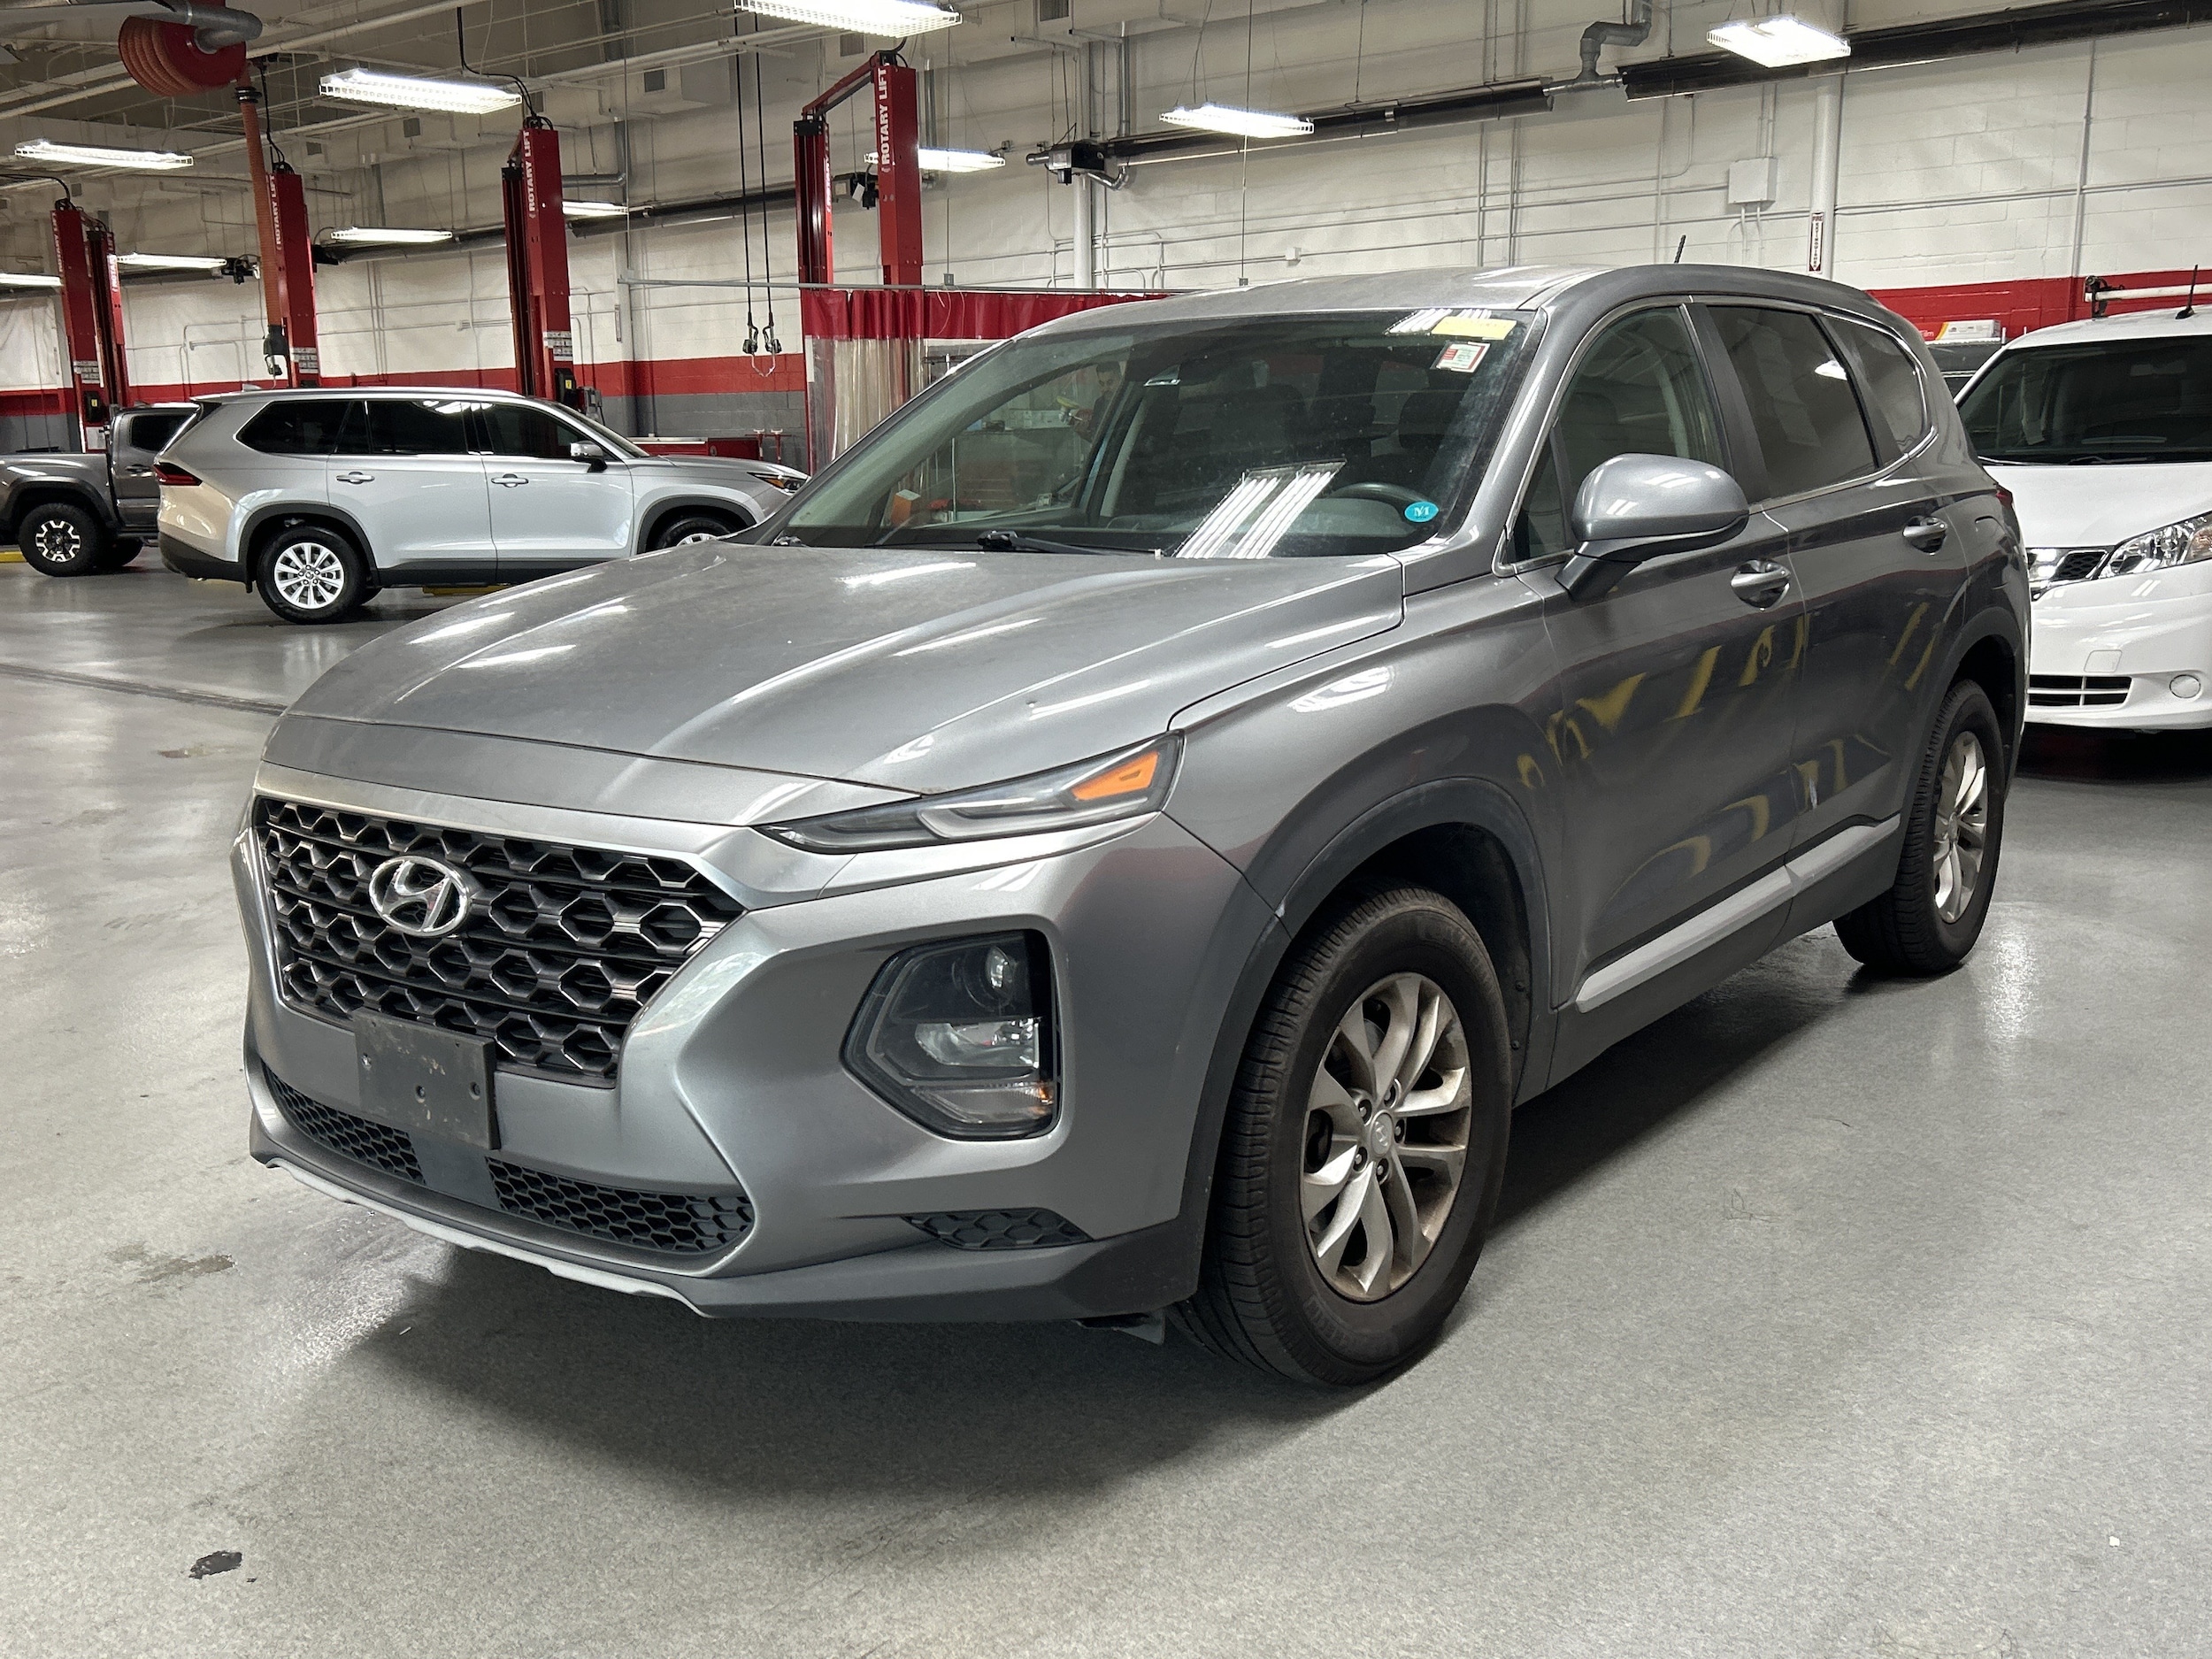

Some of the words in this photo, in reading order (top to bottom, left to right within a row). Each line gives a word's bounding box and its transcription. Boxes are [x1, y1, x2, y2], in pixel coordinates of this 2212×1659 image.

[878, 68, 887, 100] LIFT
[523, 130, 532, 157] LIFT
[879, 104, 889, 165] ROTARY
[526, 161, 535, 211] ROTARY
[273, 201, 281, 244] ROTARY
